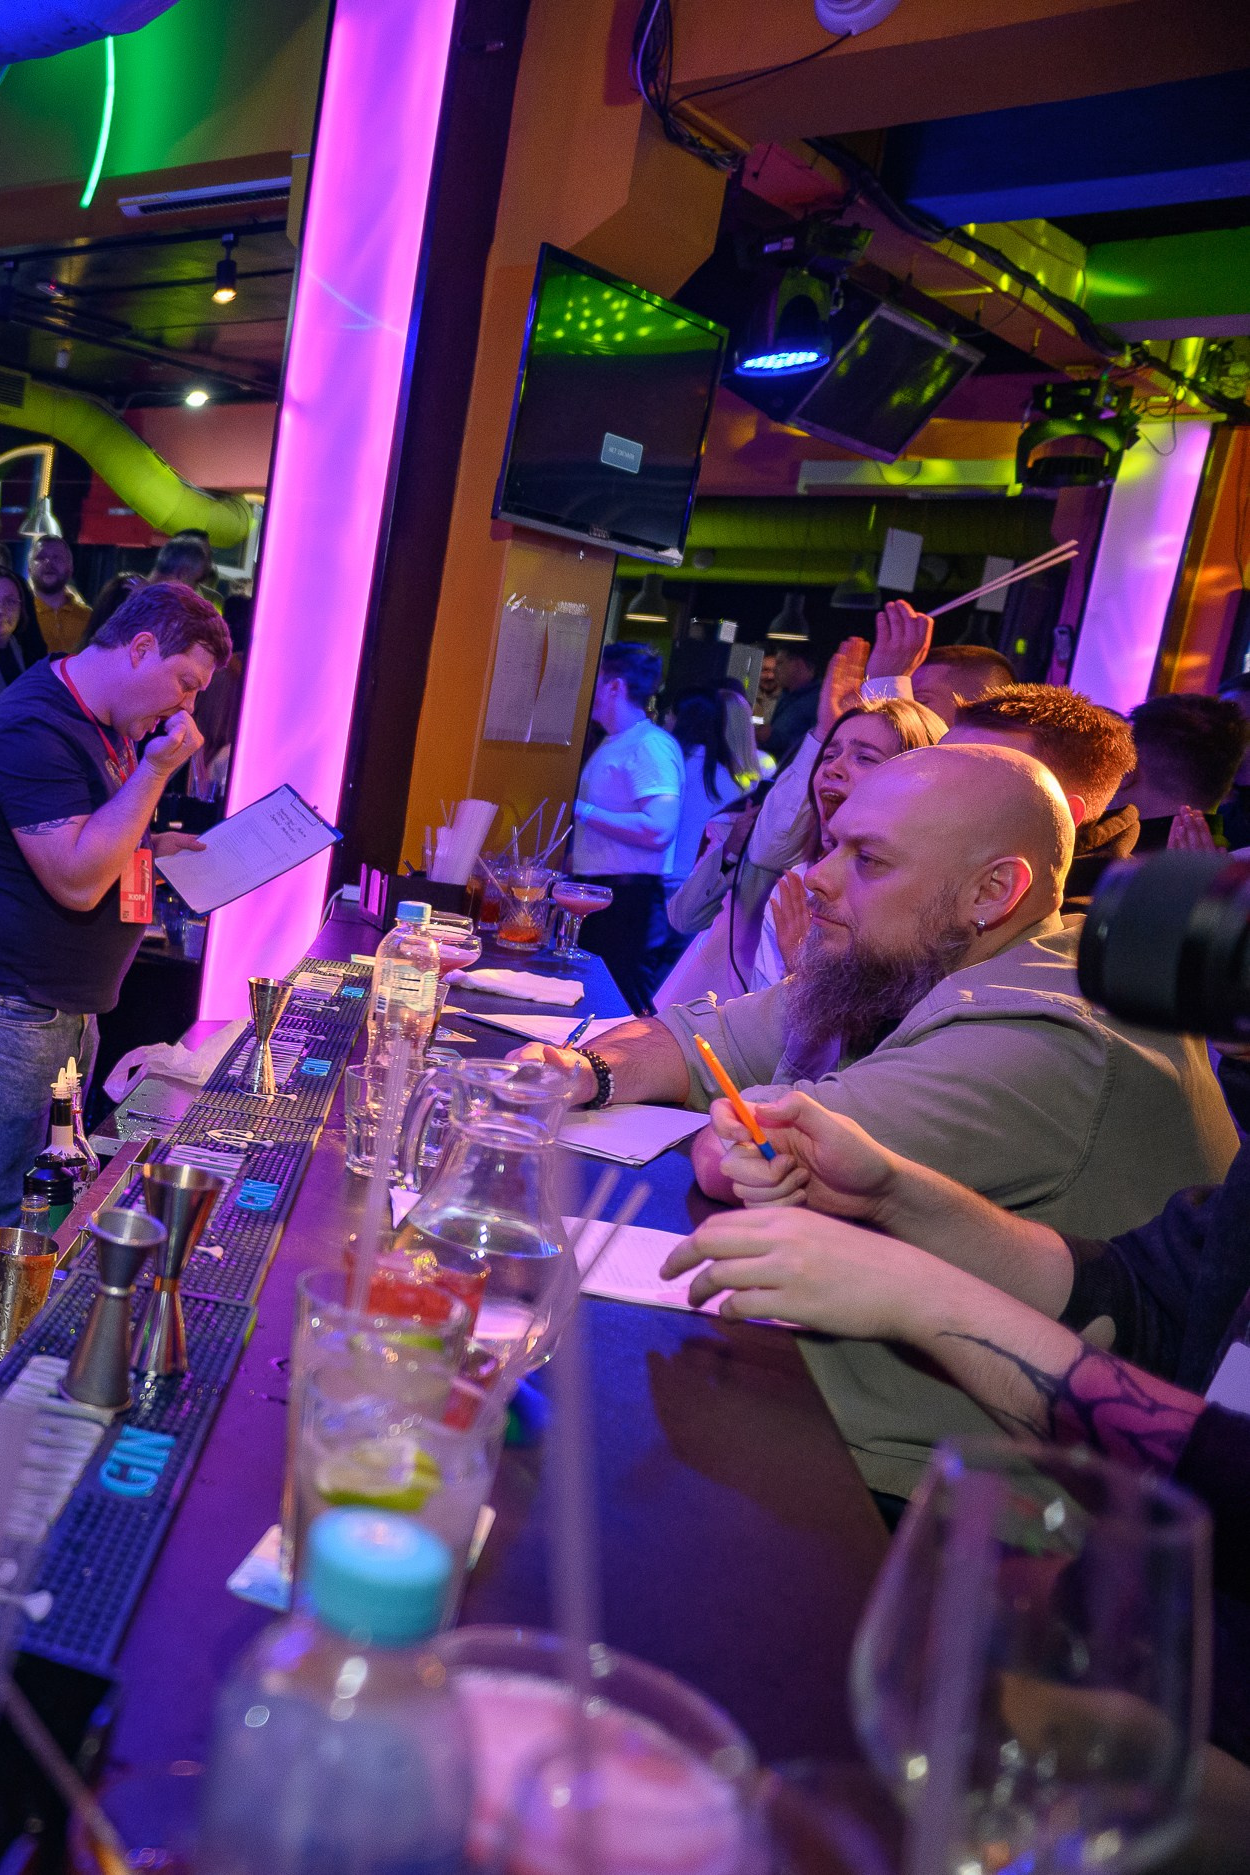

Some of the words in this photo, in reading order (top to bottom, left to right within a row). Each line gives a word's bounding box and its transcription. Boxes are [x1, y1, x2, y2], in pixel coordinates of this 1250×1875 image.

[128, 893, 146, 902] ЖЮРИ
[235, 1178, 281, 1211] GIN
[100, 1424, 177, 1498] GIN
